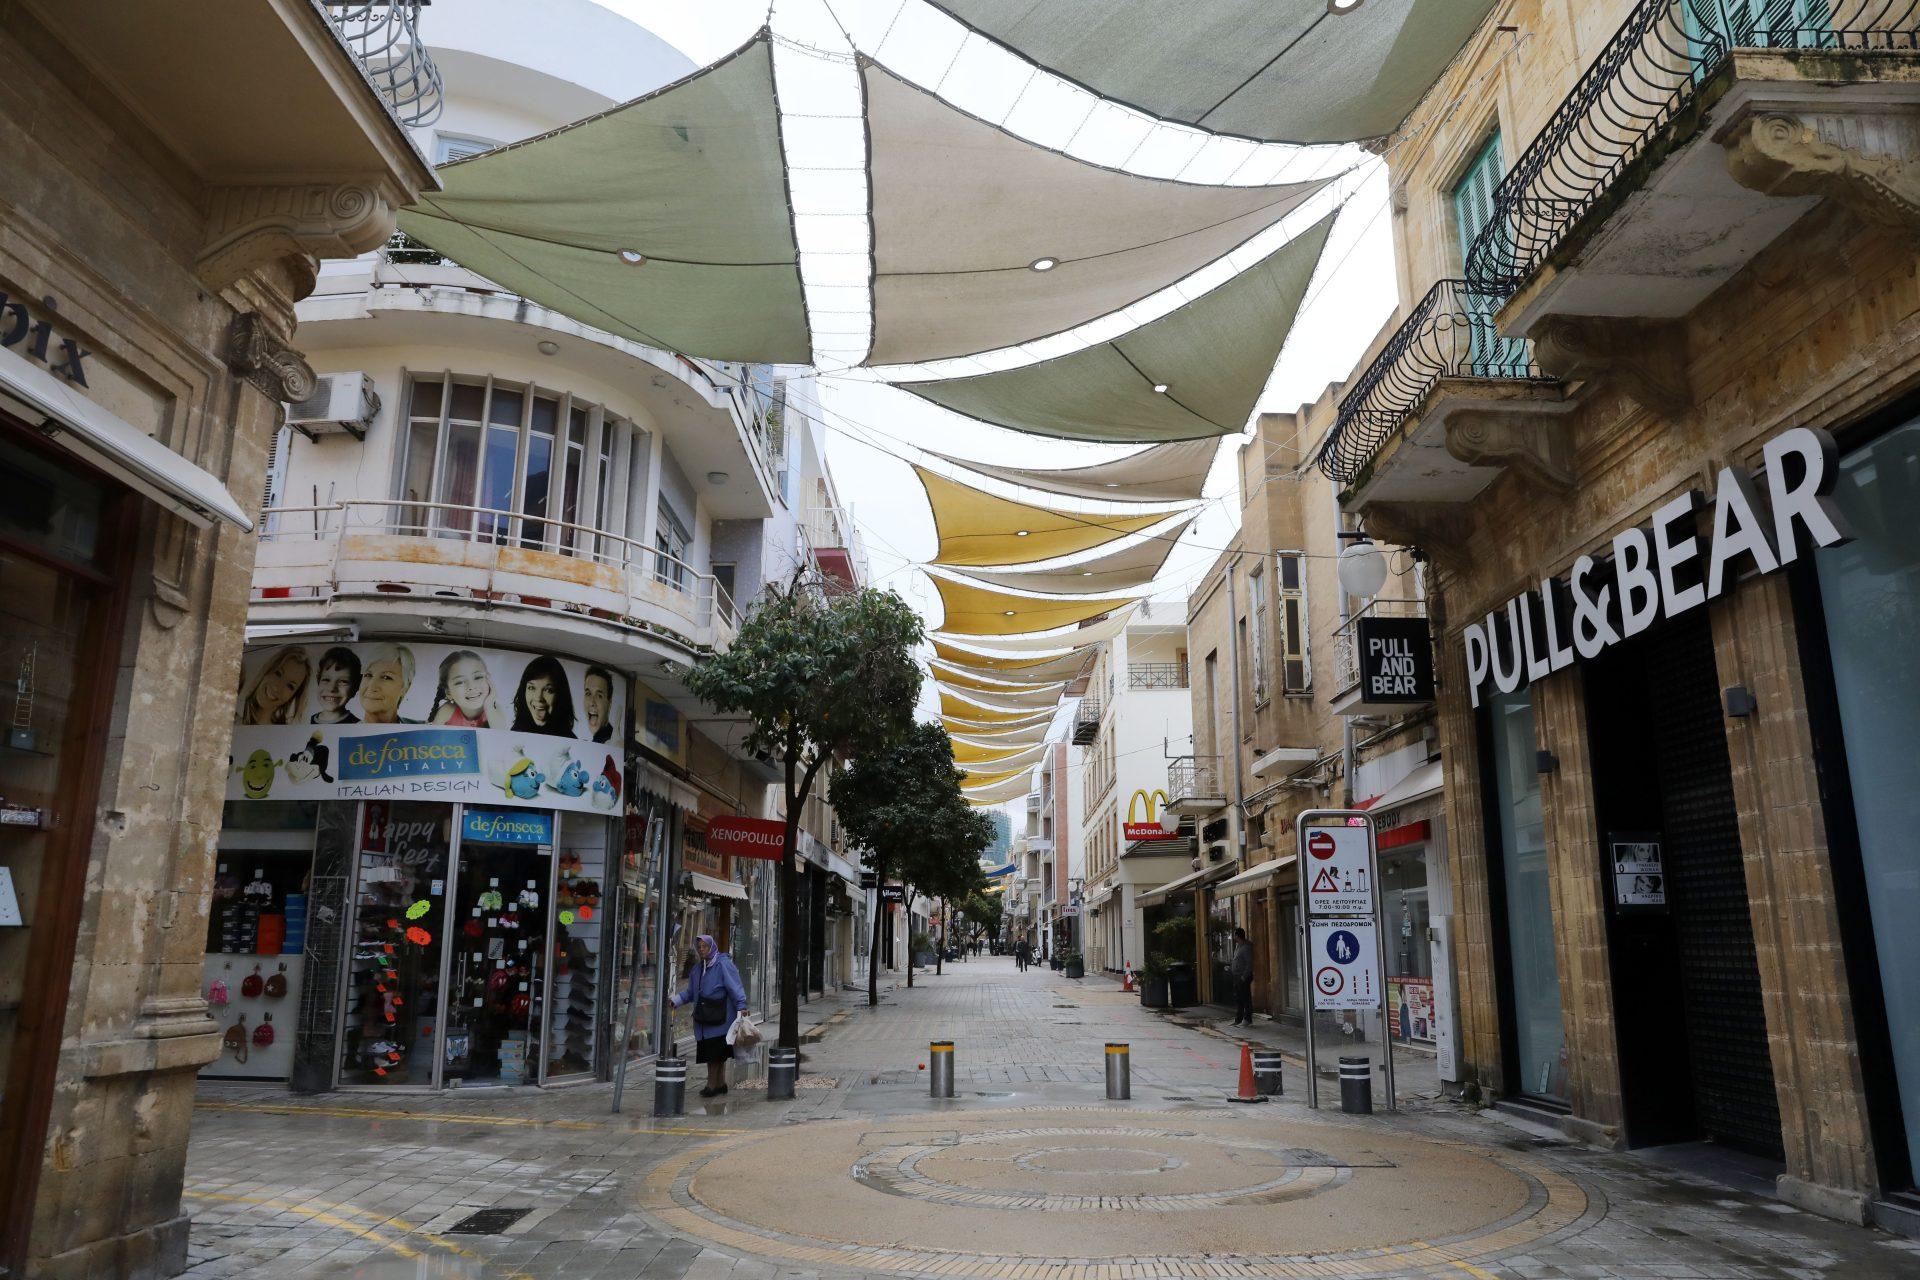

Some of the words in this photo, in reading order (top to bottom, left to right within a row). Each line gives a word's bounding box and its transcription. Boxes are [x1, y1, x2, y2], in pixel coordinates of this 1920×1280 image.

[1463, 426, 1845, 710] PULL&BEAR
[1369, 638, 1414, 658] PULL
[1380, 657, 1416, 677] AND
[1371, 676, 1417, 696] BEAR
[387, 761, 465, 773] ITALY
[337, 784, 405, 797] ITALIAN
[411, 780, 481, 793] DESIGN
[496, 833, 542, 841] ITALY
